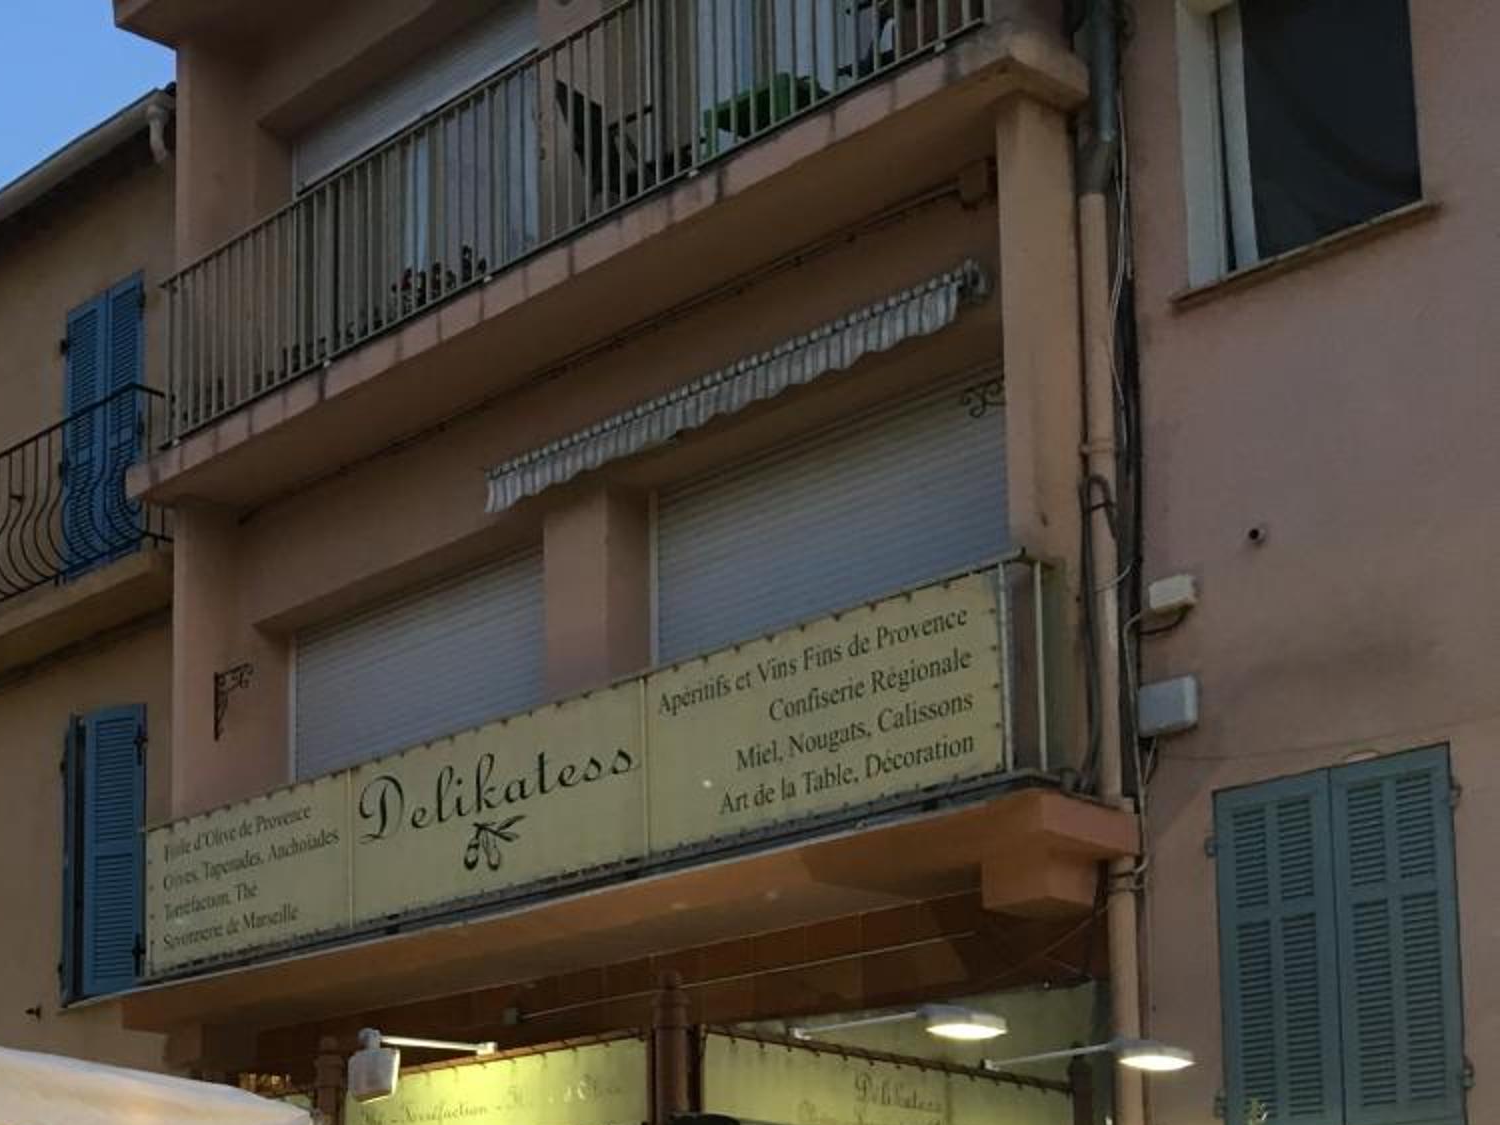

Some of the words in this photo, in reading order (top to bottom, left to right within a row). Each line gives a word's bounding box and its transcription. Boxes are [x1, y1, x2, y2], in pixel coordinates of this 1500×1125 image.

[658, 674, 732, 718] Apéritifs
[735, 671, 751, 690] et
[757, 656, 798, 684] Vins
[803, 644, 843, 672] Fins
[847, 634, 871, 657] de
[877, 608, 969, 650] Provence
[769, 676, 865, 722] Confiserie
[871, 648, 973, 695] Régionale
[736, 740, 784, 772] Miel,
[789, 720, 872, 760] Nougats,
[877, 692, 975, 733] Calissons
[359, 749, 640, 845] Delikatess
[719, 789, 752, 816] Art
[753, 783, 776, 806] de
[781, 777, 797, 800] la
[802, 764, 860, 798] Table,
[865, 734, 976, 780] Décoration
[239, 819, 254, 837] de
[255, 804, 312, 832] Provence
[242, 902, 299, 930] Marseille
